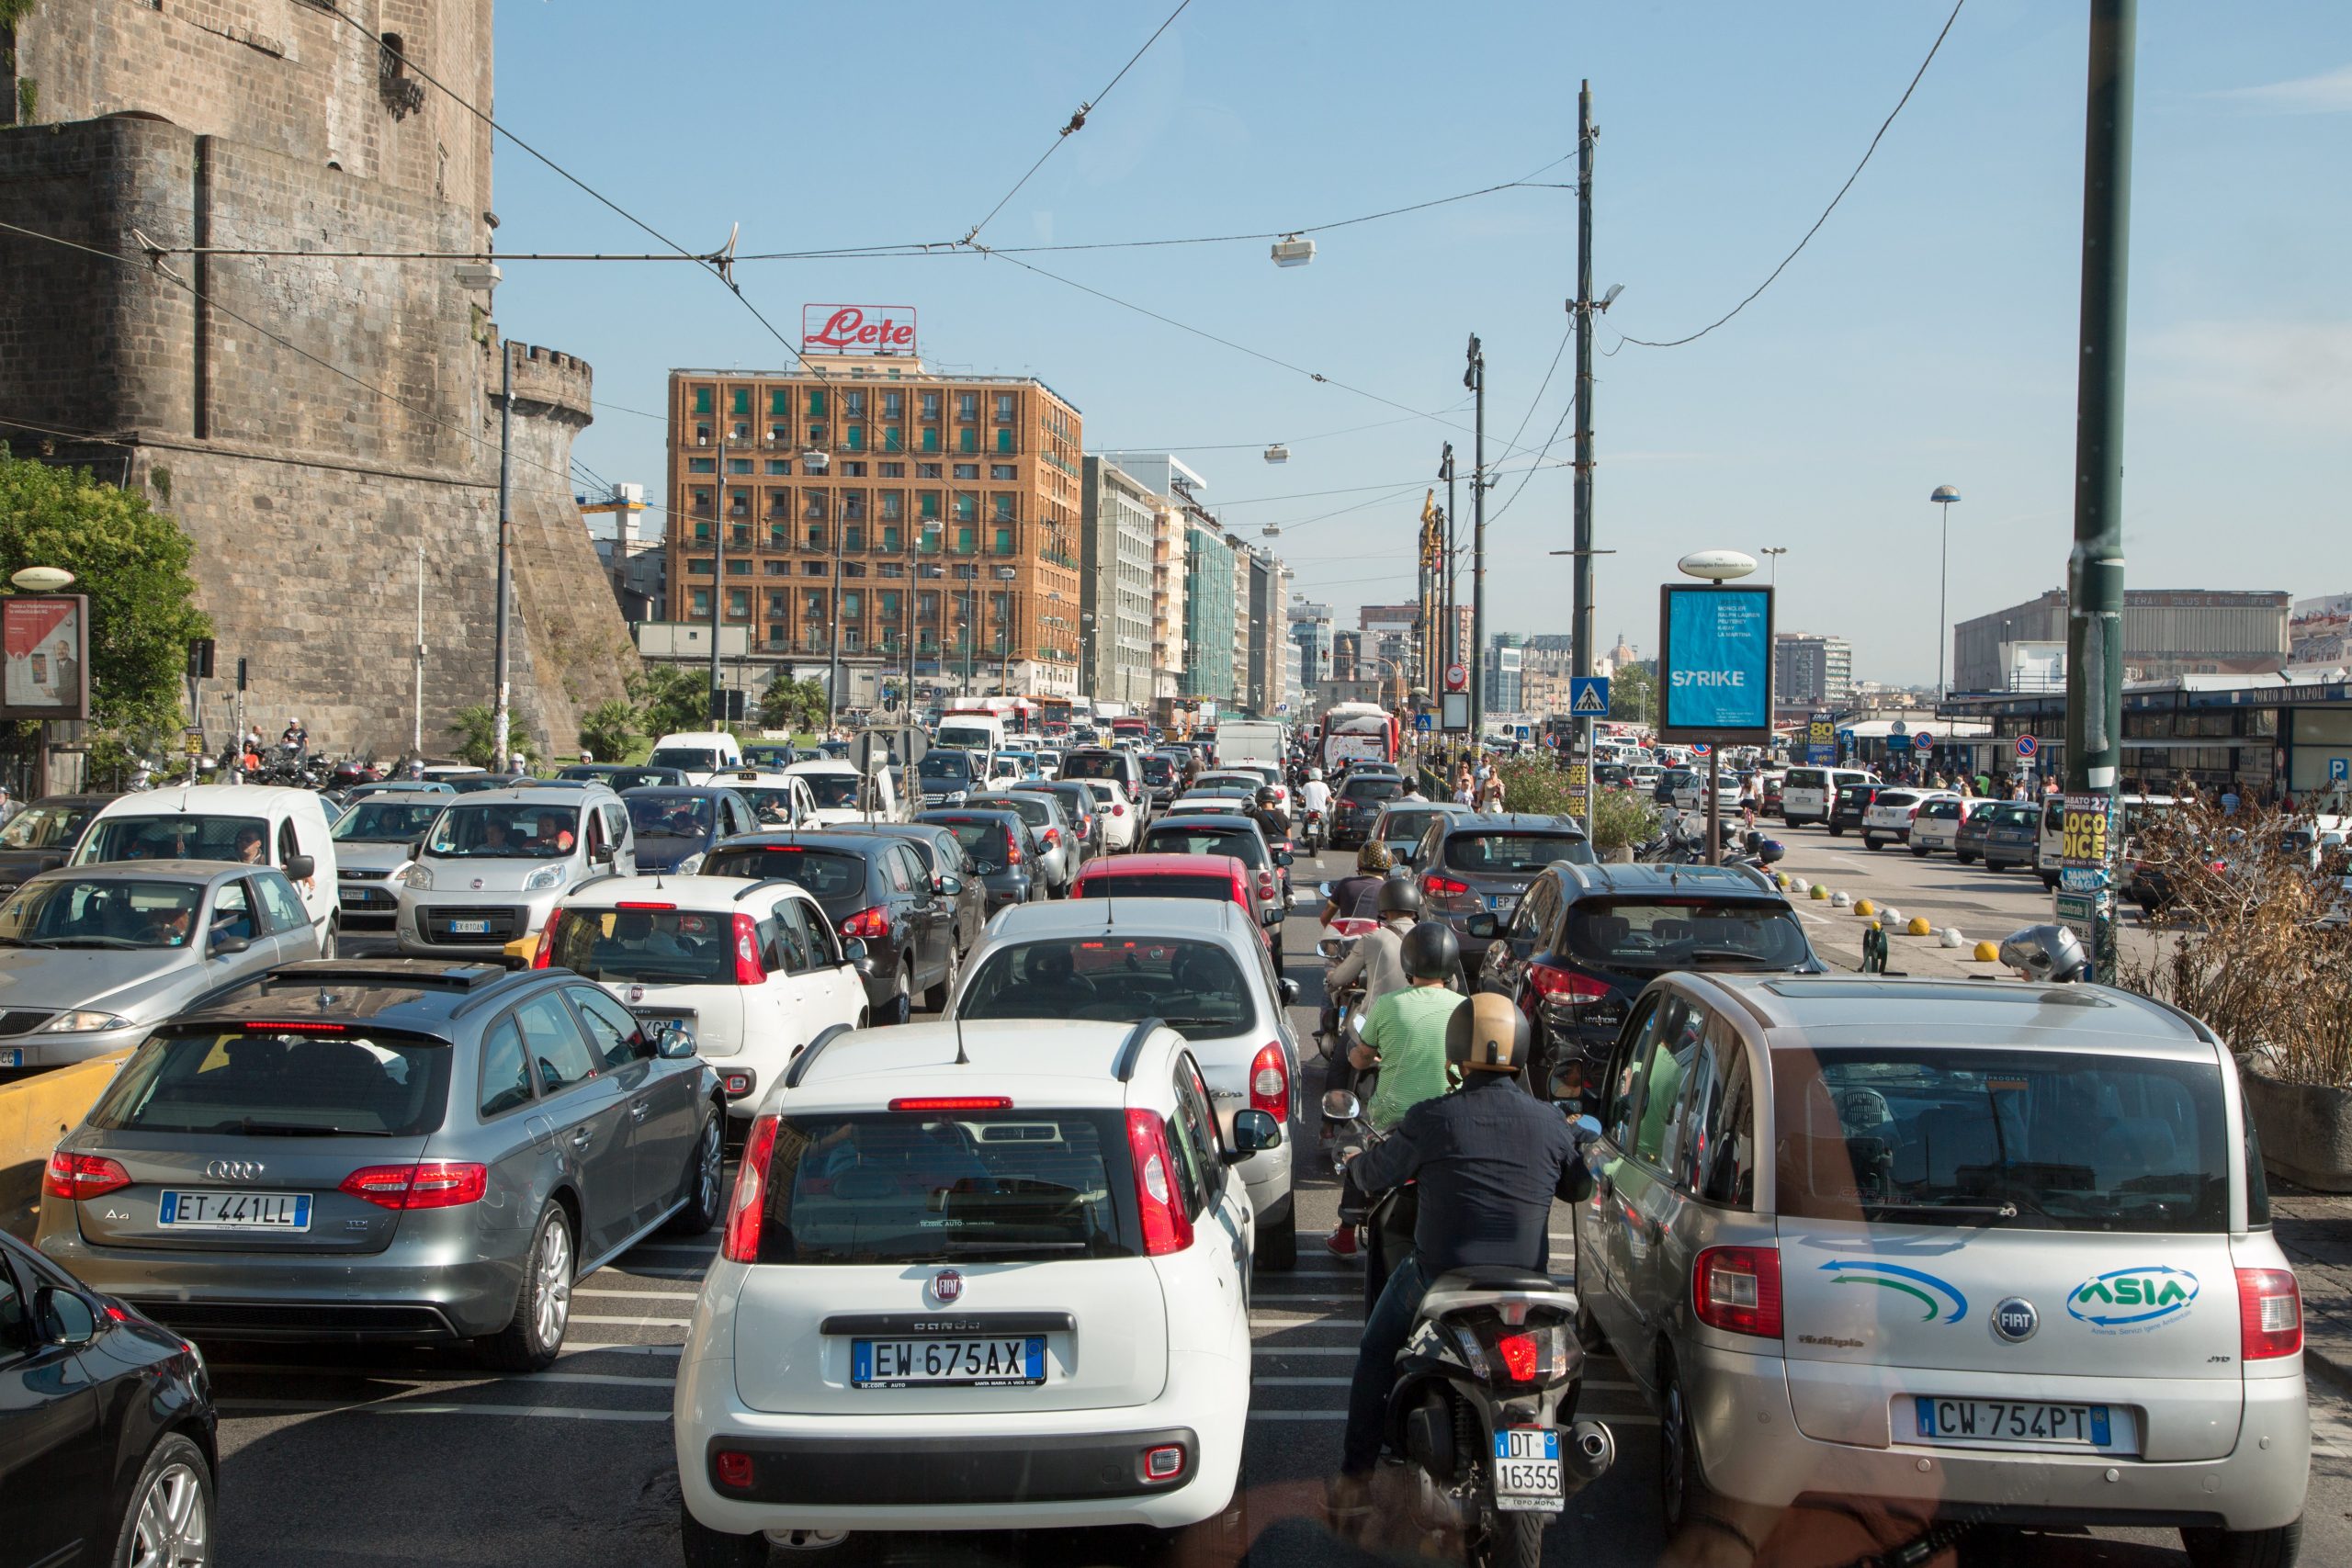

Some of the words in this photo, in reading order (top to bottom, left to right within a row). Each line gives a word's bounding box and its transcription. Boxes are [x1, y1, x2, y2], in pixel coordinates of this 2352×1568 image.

[805, 308, 913, 346] Lete
[1671, 670, 1746, 687] STRIKE
[2253, 690, 2278, 703] PORTO
[2282, 689, 2291, 701] DI
[2296, 686, 2327, 700] NAPOLI
[1810, 721, 1835, 736] 80
[2332, 761, 2345, 779] P
[2090, 796, 2109, 811] 27
[2064, 812, 2106, 834] LOCO
[2063, 833, 2106, 859] DICE
[104, 1208, 130, 1220] A4
[177, 1195, 209, 1221] ET
[217, 1196, 291, 1224] 441LL
[938, 1279, 959, 1294] FIAT
[2078, 1277, 2191, 1307] ASIA
[2001, 1313, 2030, 1327] FIAT
[2090, 1327, 2117, 1336] Azienda
[876, 1343, 912, 1376] EW
[925, 1342, 1021, 1376] 675AX
[1939, 1402, 1975, 1435] CW
[1988, 1404, 2086, 1440] 754PT
[1510, 1433, 1533, 1457] DT
[1501, 1464, 1559, 1490] 16355
